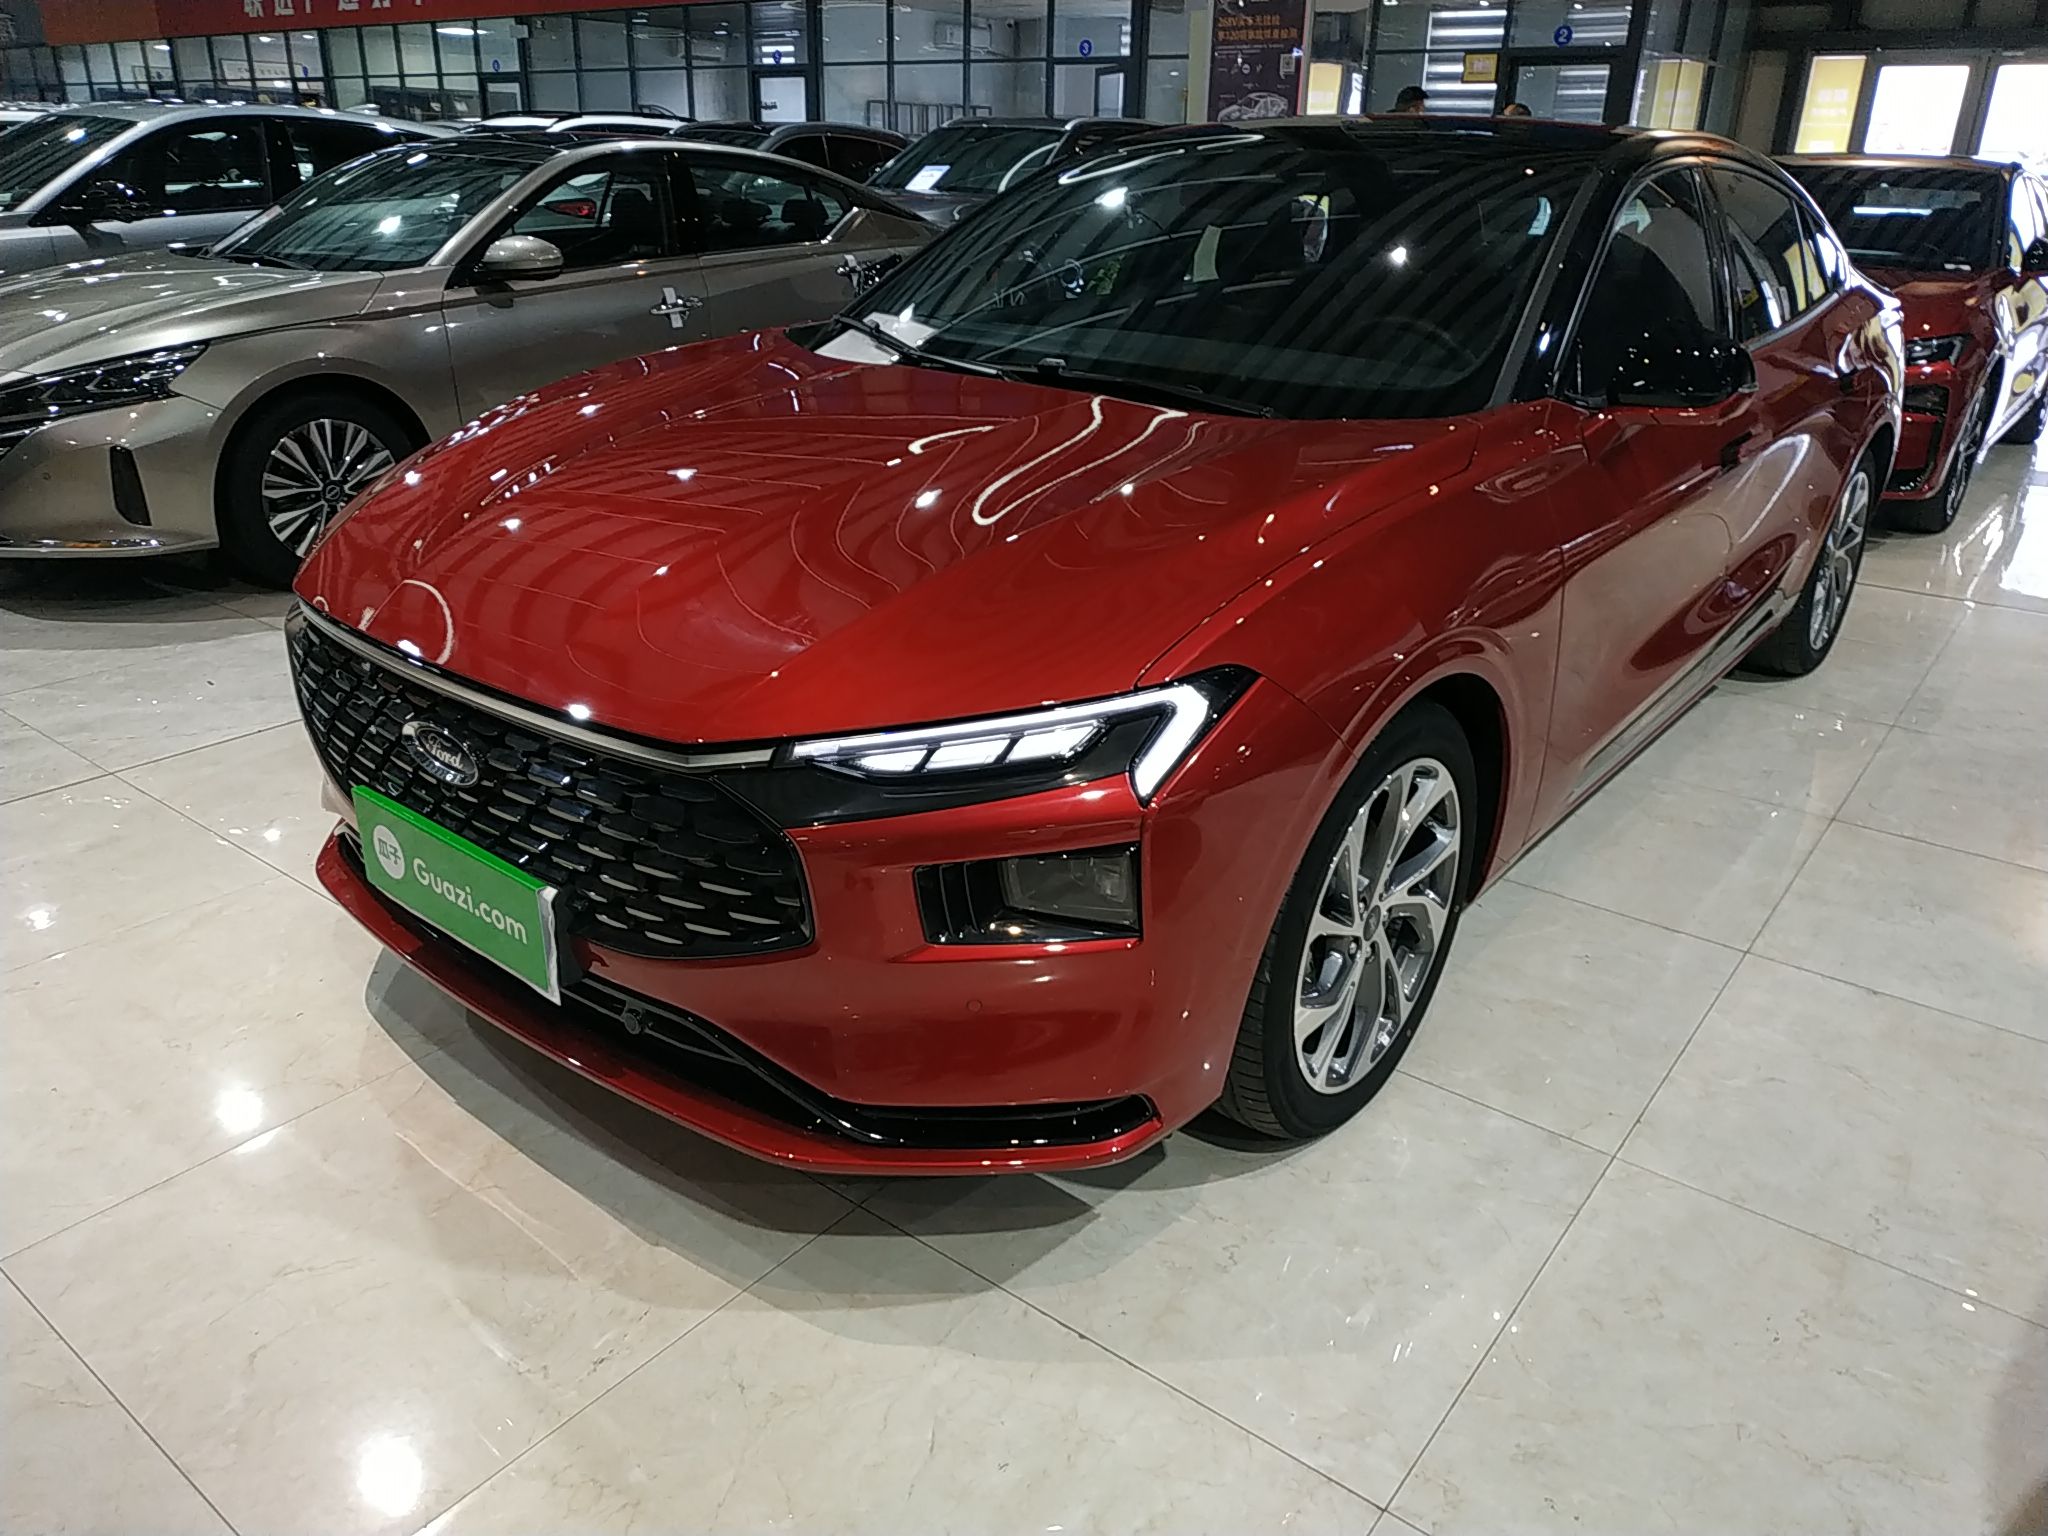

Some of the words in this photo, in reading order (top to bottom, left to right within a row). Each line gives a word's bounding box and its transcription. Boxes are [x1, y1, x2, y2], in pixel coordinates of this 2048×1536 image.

[1559, 29, 1568, 42] 2
[426, 733, 464, 769] Ford
[377, 836, 402, 866] 瓜子
[412, 857, 528, 945] Guazi.com
